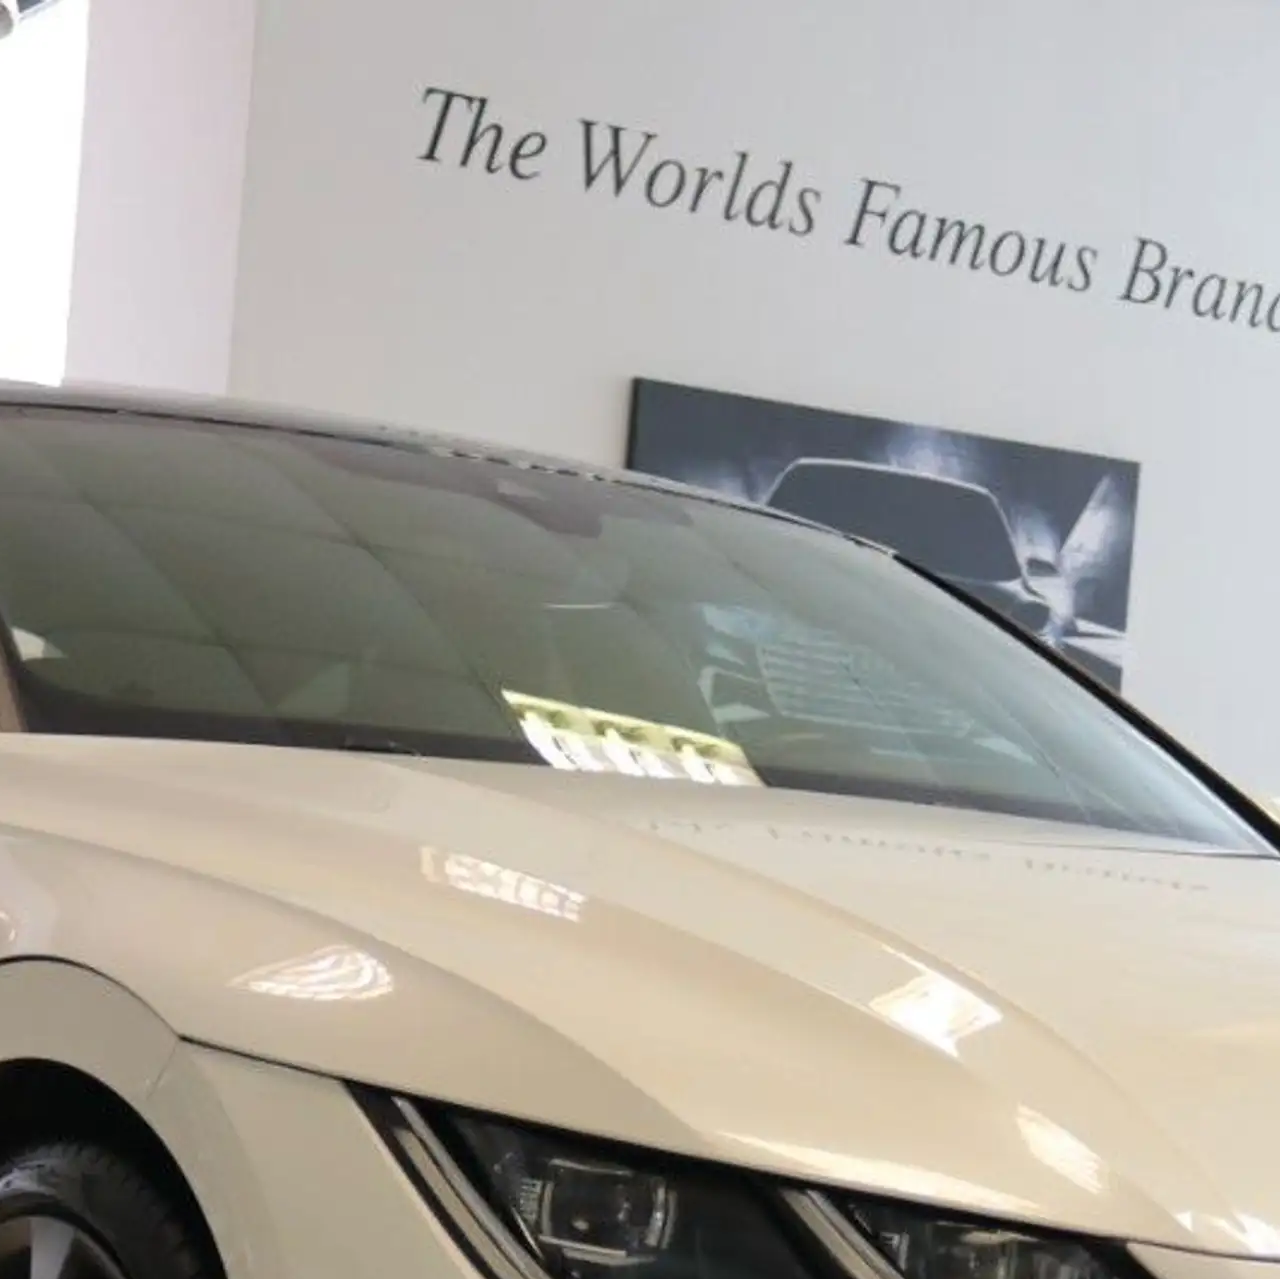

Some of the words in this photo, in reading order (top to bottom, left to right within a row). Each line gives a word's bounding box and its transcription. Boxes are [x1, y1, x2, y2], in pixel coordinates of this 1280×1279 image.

[417, 86, 548, 181] The
[579, 119, 822, 236] Worlds
[843, 178, 1098, 293] Famous
